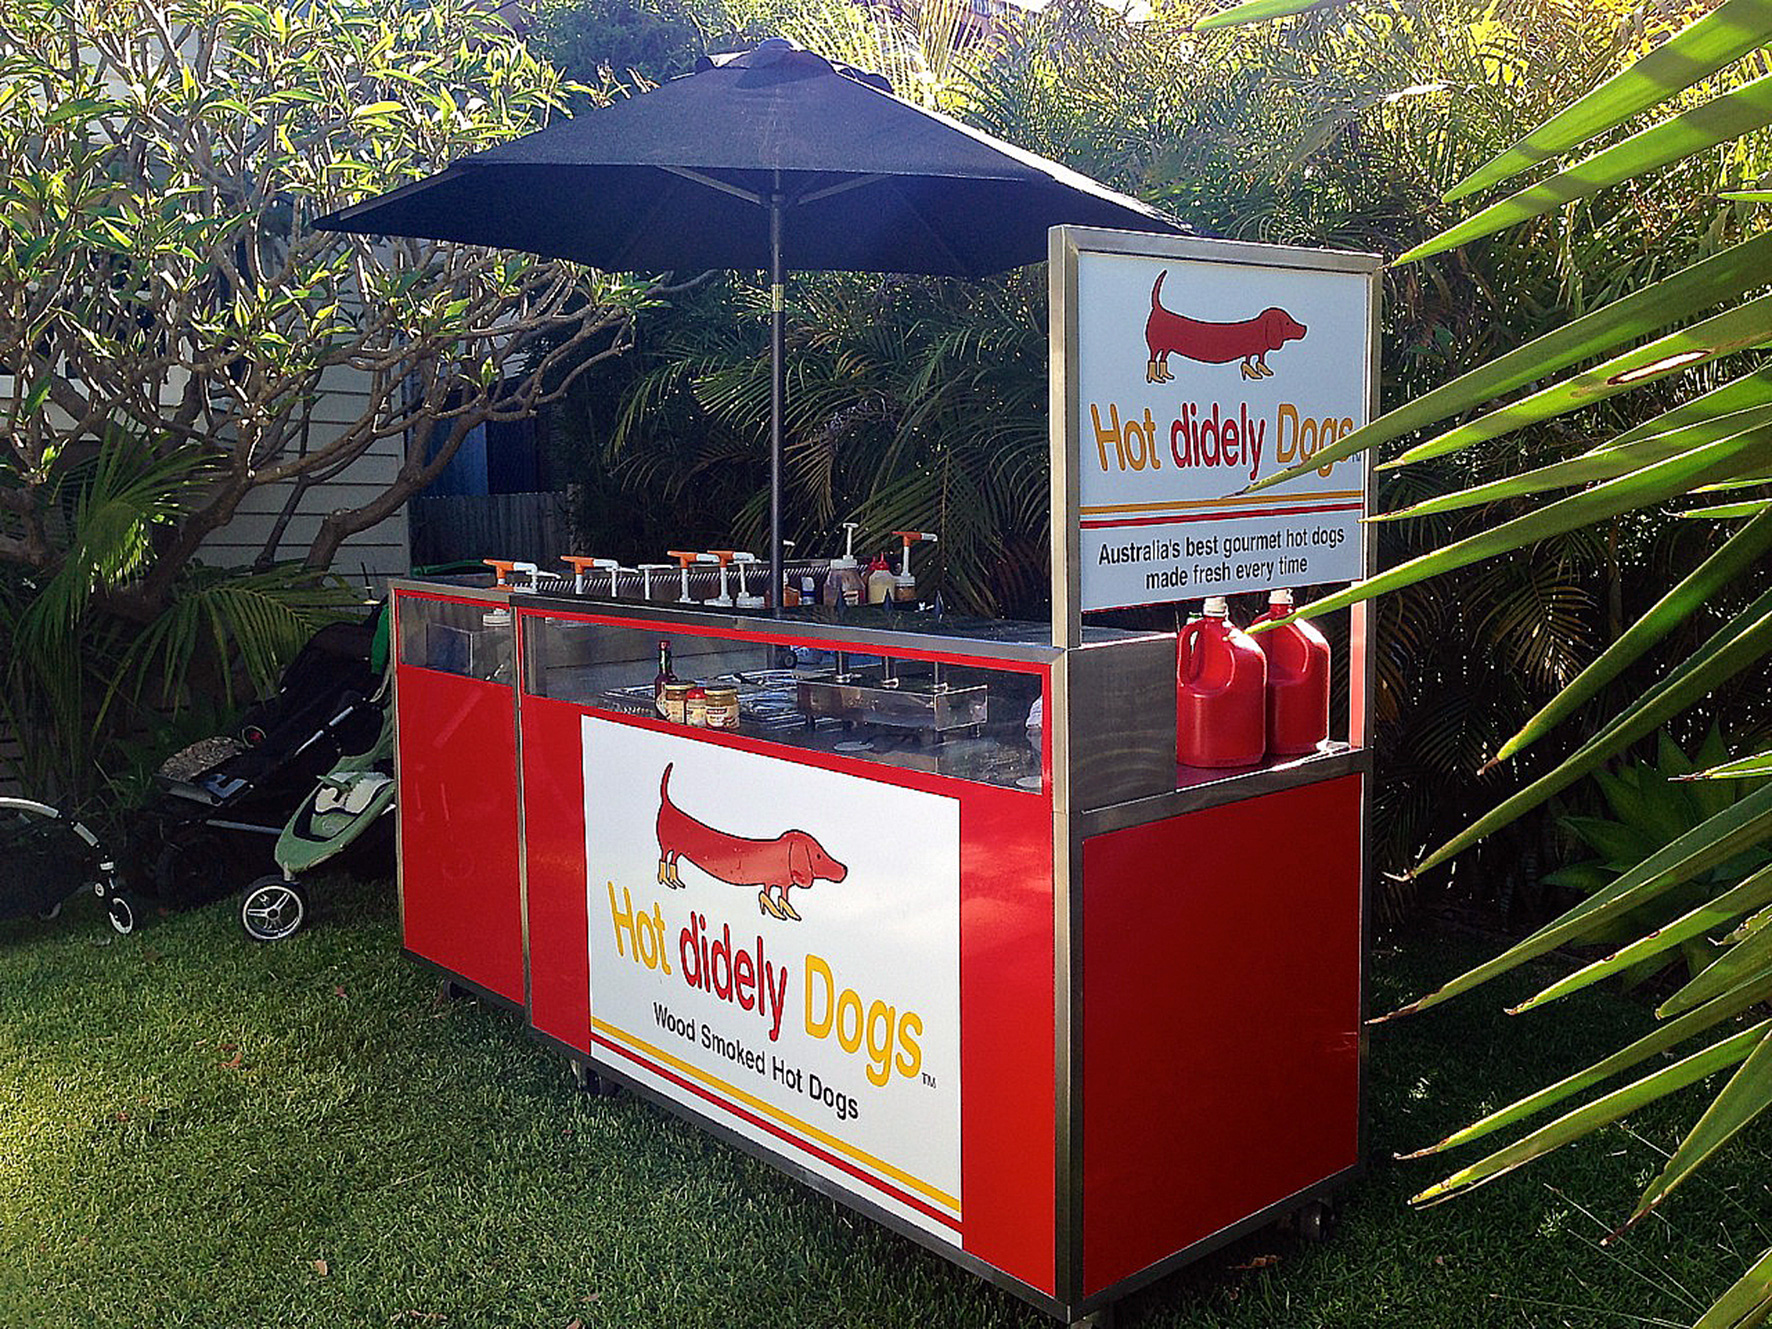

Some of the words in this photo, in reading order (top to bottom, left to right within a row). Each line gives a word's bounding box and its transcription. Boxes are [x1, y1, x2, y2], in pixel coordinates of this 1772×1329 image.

[1090, 402, 1161, 472] Hot
[1170, 402, 1266, 480] didely
[1098, 539, 1180, 565] Australia's
[1185, 536, 1219, 557] best
[1223, 530, 1282, 558] gourmet
[1286, 528, 1308, 547] hot
[1312, 525, 1345, 548] dogs
[1145, 565, 1188, 590] made
[1193, 561, 1231, 584] fresh
[1235, 561, 1274, 581] every
[1279, 555, 1308, 575] time
[607, 881, 672, 976] Hot
[679, 910, 788, 1042] didely
[804, 953, 923, 1087] Dogs
[653, 1001, 696, 1042] Wood
[701, 1023, 766, 1076] Smoked
[772, 1055, 803, 1093] Hot
[809, 1073, 859, 1121] Dogs
